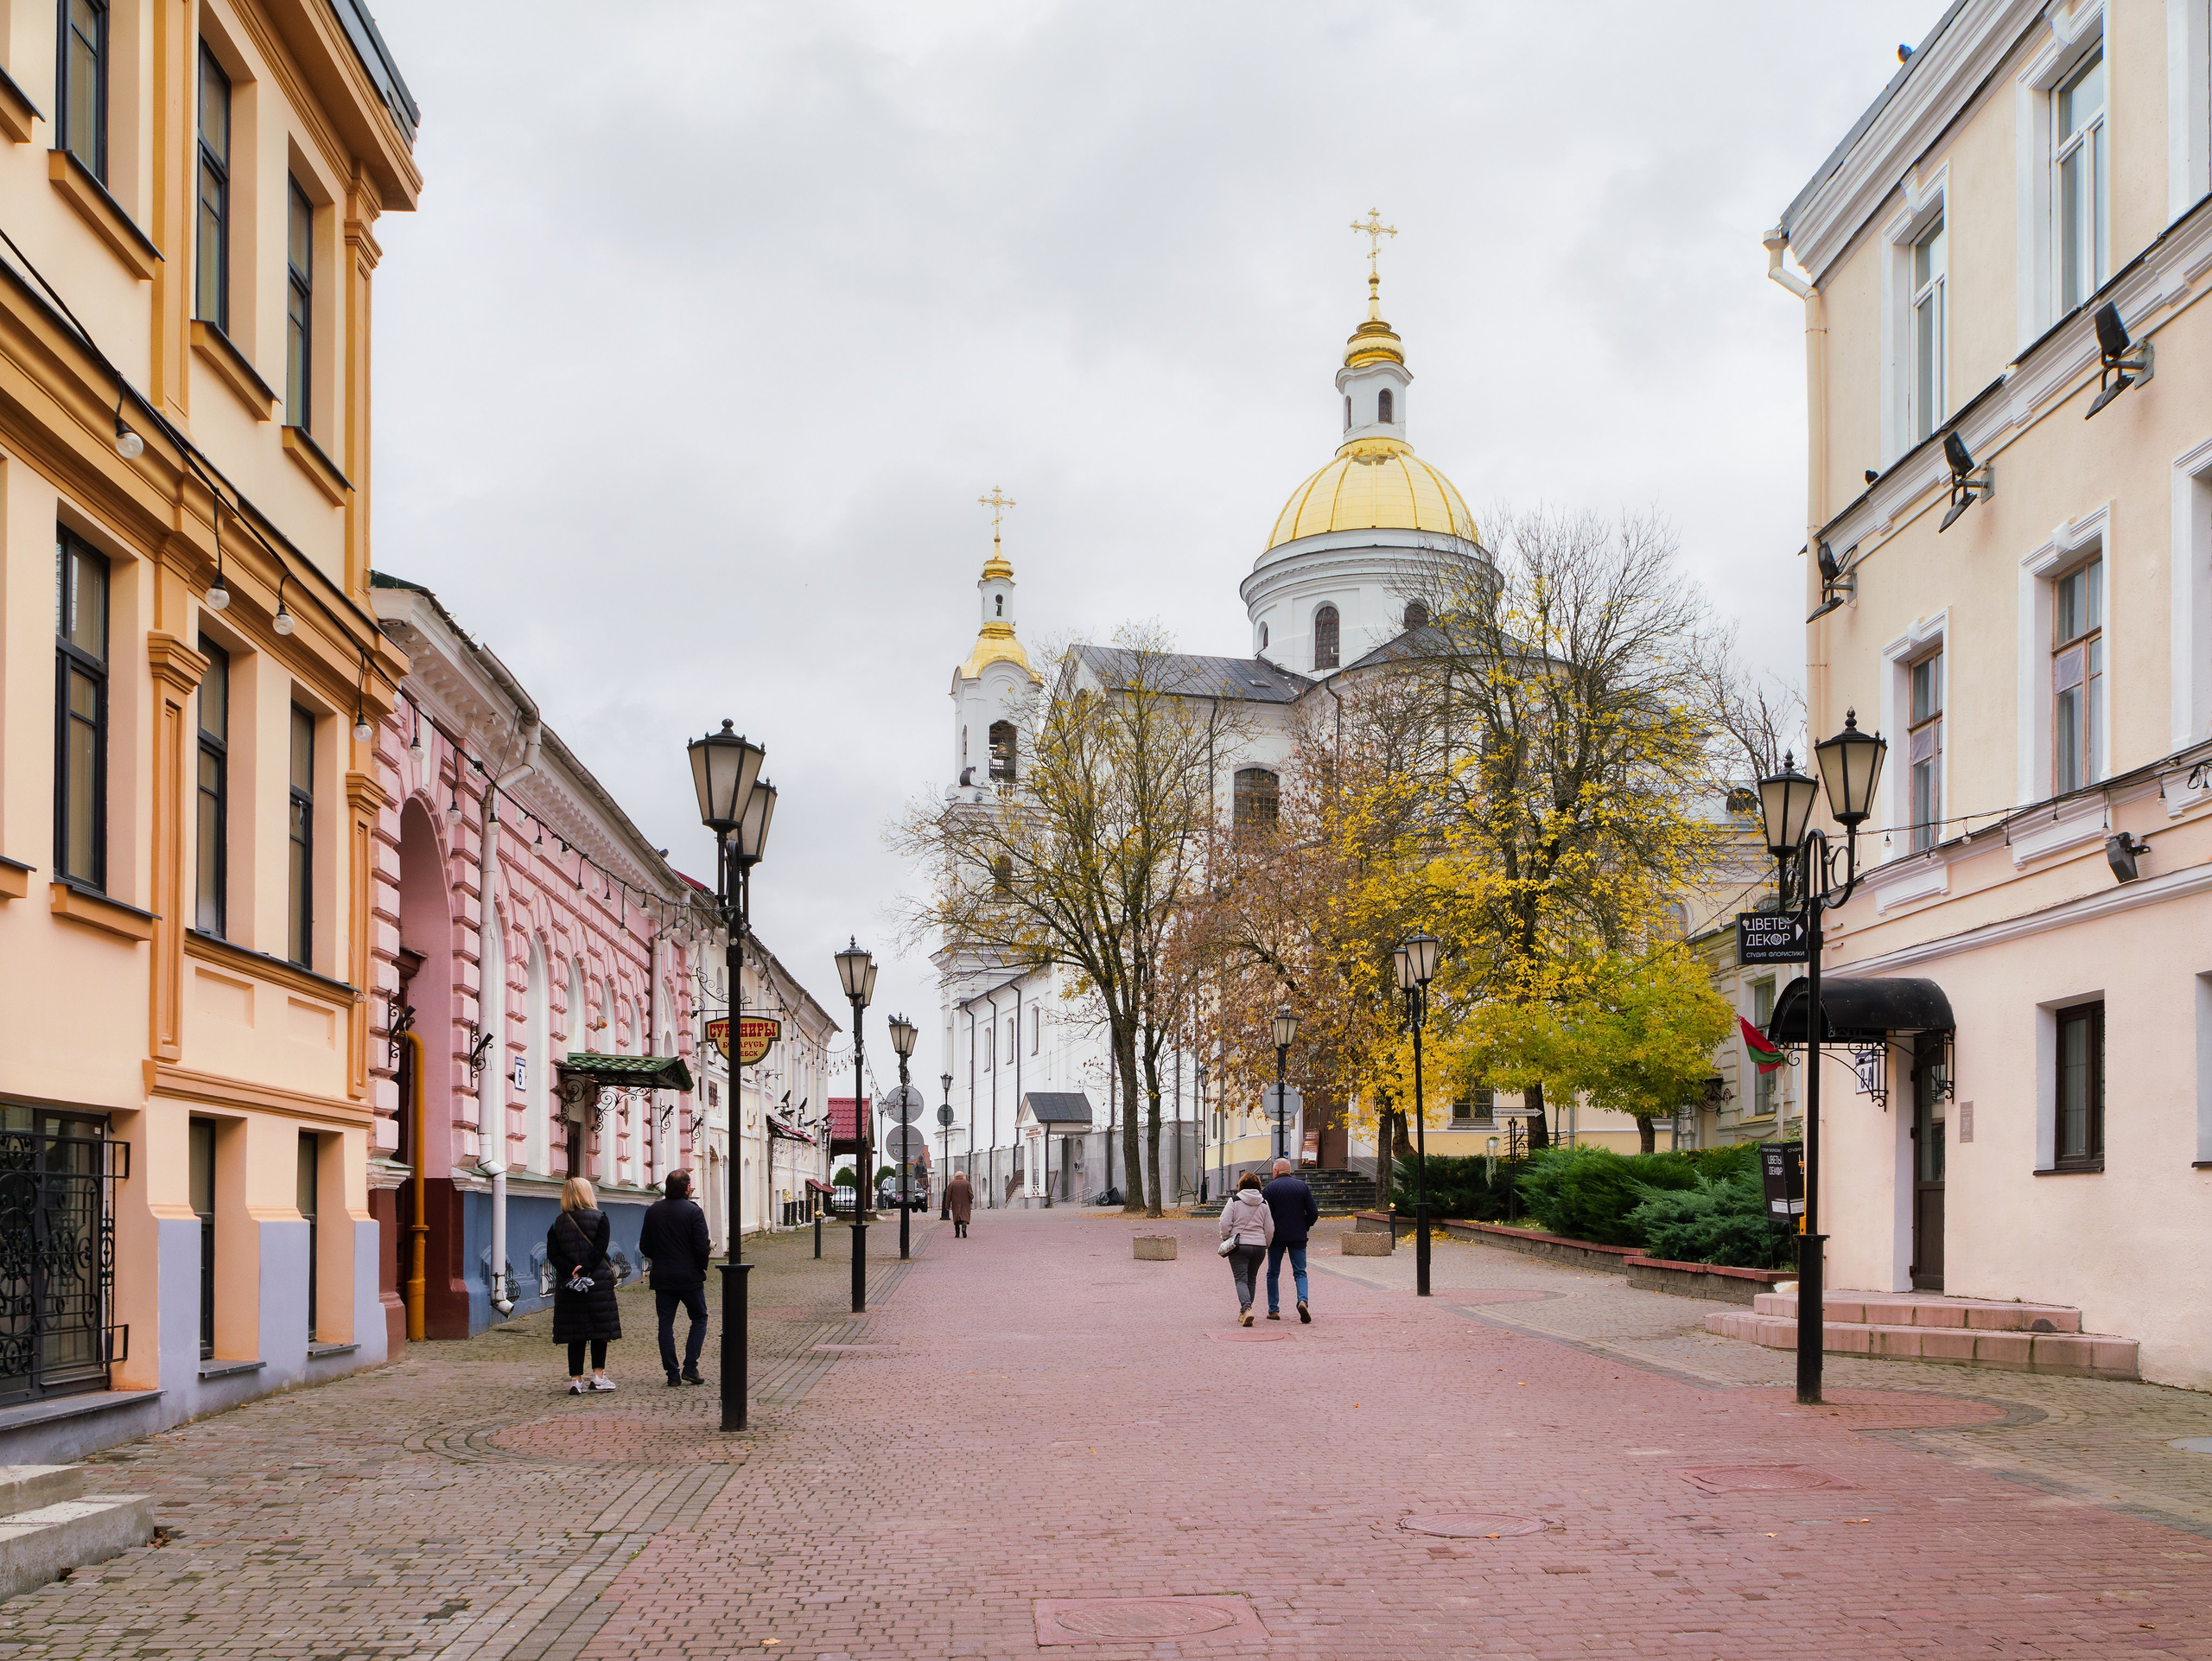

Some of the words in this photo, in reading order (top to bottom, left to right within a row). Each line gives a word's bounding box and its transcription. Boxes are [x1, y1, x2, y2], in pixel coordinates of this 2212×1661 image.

[1745, 917, 1790, 931] ЦВЕТЫ
[1745, 933, 1791, 946] ДЕКОР
[709, 1022, 776, 1038] СУВНИРЫ
[518, 1068, 523, 1086] 6
